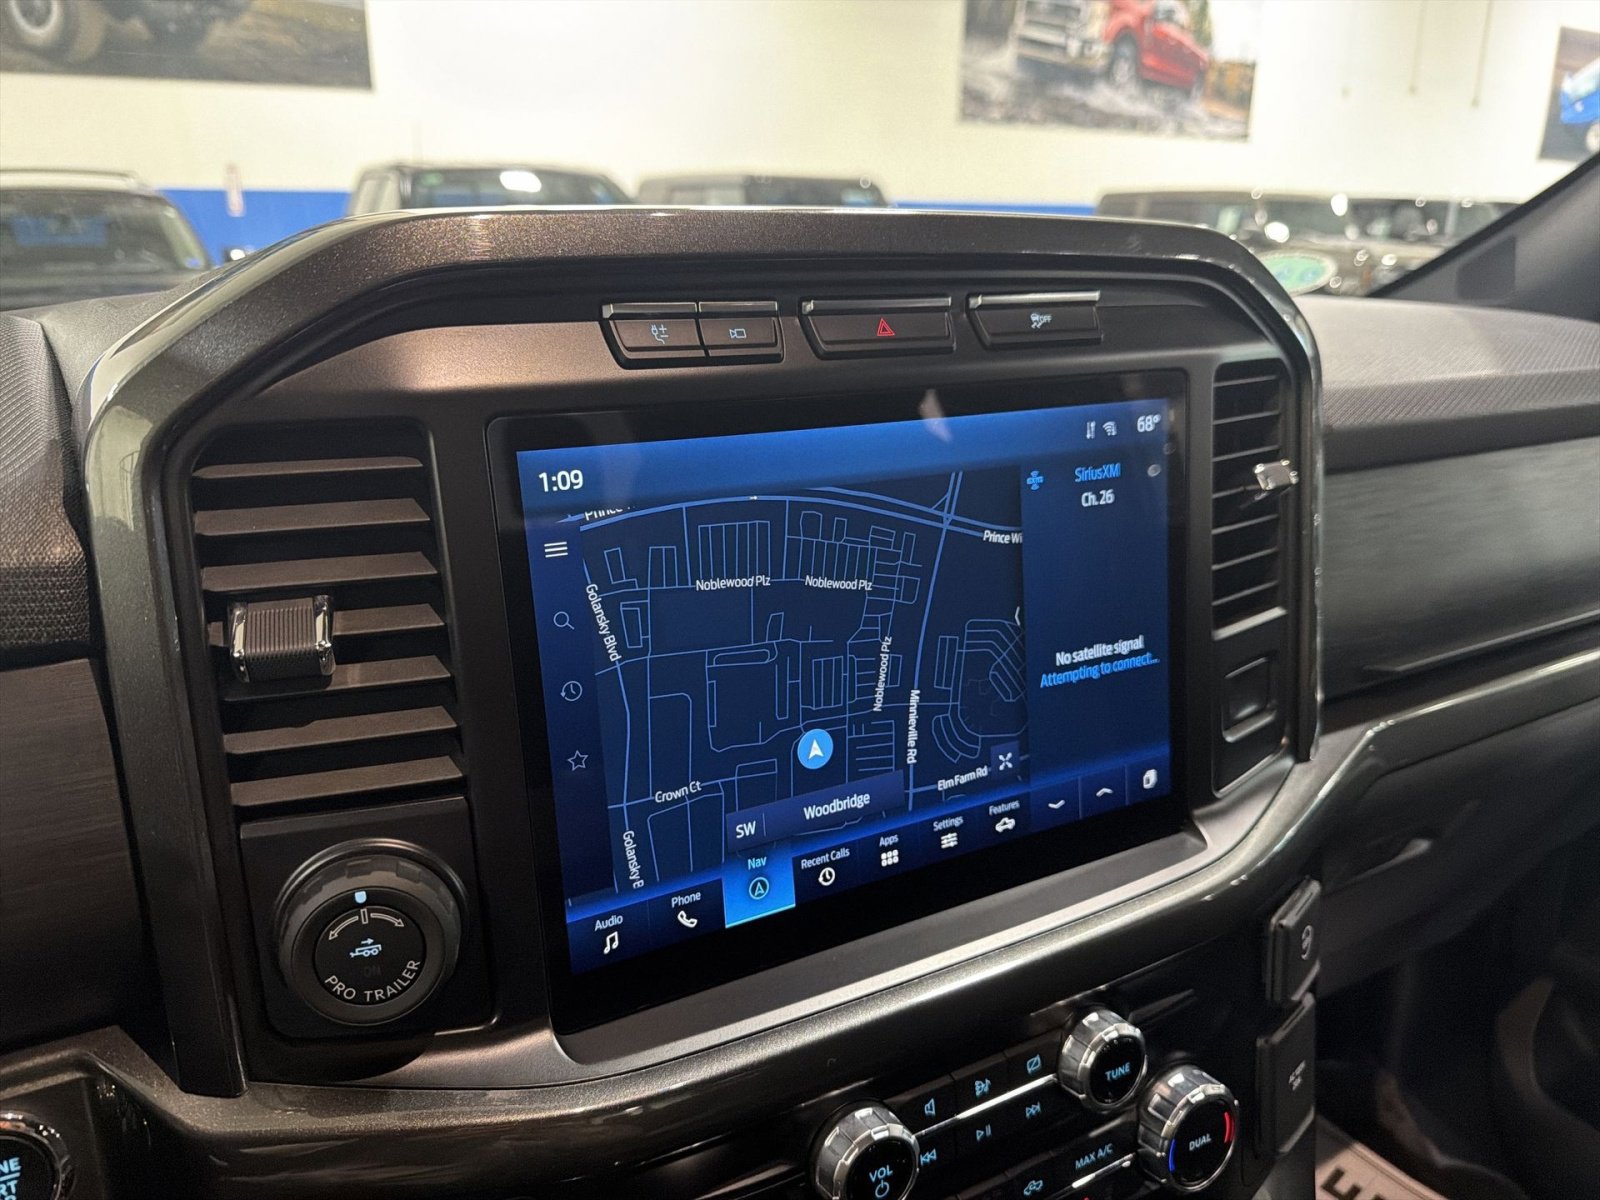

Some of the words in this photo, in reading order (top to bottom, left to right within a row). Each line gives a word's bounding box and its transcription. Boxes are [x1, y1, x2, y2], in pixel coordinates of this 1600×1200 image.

[538, 469, 584, 493] 1:09
[1074, 463, 1121, 482] SiriusXM
[1099, 489, 1115, 505] 26
[983, 529, 1010, 544] Prince
[696, 576, 753, 591] Noblewood
[755, 575, 771, 587] Plz
[805, 575, 857, 590] Noblewood
[858, 579, 873, 591] Plz
[585, 583, 611, 635] Golansky
[603, 634, 622, 662] Blvd
[1055, 651, 1072, 667] No
[1072, 643, 1113, 663] satellite
[1113, 634, 1144, 655] signal
[873, 653, 889, 712] Noblewood
[881, 636, 892, 653] Plz
[1040, 664, 1100, 688] Attempting
[1100, 661, 1113, 675] to
[907, 689, 921, 748] Minnieville
[906, 748, 918, 764] Rd
[937, 779, 955, 791] Elm
[954, 771, 977, 786] Farm
[976, 765, 989, 779] Rd
[654, 786, 688, 803] Crown
[688, 780, 702, 795] Ct
[803, 793, 871, 820] Woodbridge
[989, 800, 1020, 816] Features
[735, 821, 757, 837] SW
[933, 815, 964, 831] Settings
[879, 833, 899, 848] Apps
[623, 830, 641, 880] Golansky
[747, 855, 768, 870] Nav
[801, 853, 828, 868] Recent
[830, 848, 849, 861] Calls
[671, 890, 702, 908] Phone
[594, 914, 624, 931] Audio
[324, 974, 357, 1000] PRO
[364, 959, 421, 1002] TRAILER
[1104, 1062, 1131, 1081] TUNE
[1188, 1133, 1212, 1151] DUAL
[1075, 1152, 1096, 1169] MAX
[1096, 1143, 1114, 1159] A/C
[869, 1165, 893, 1182] VOL
